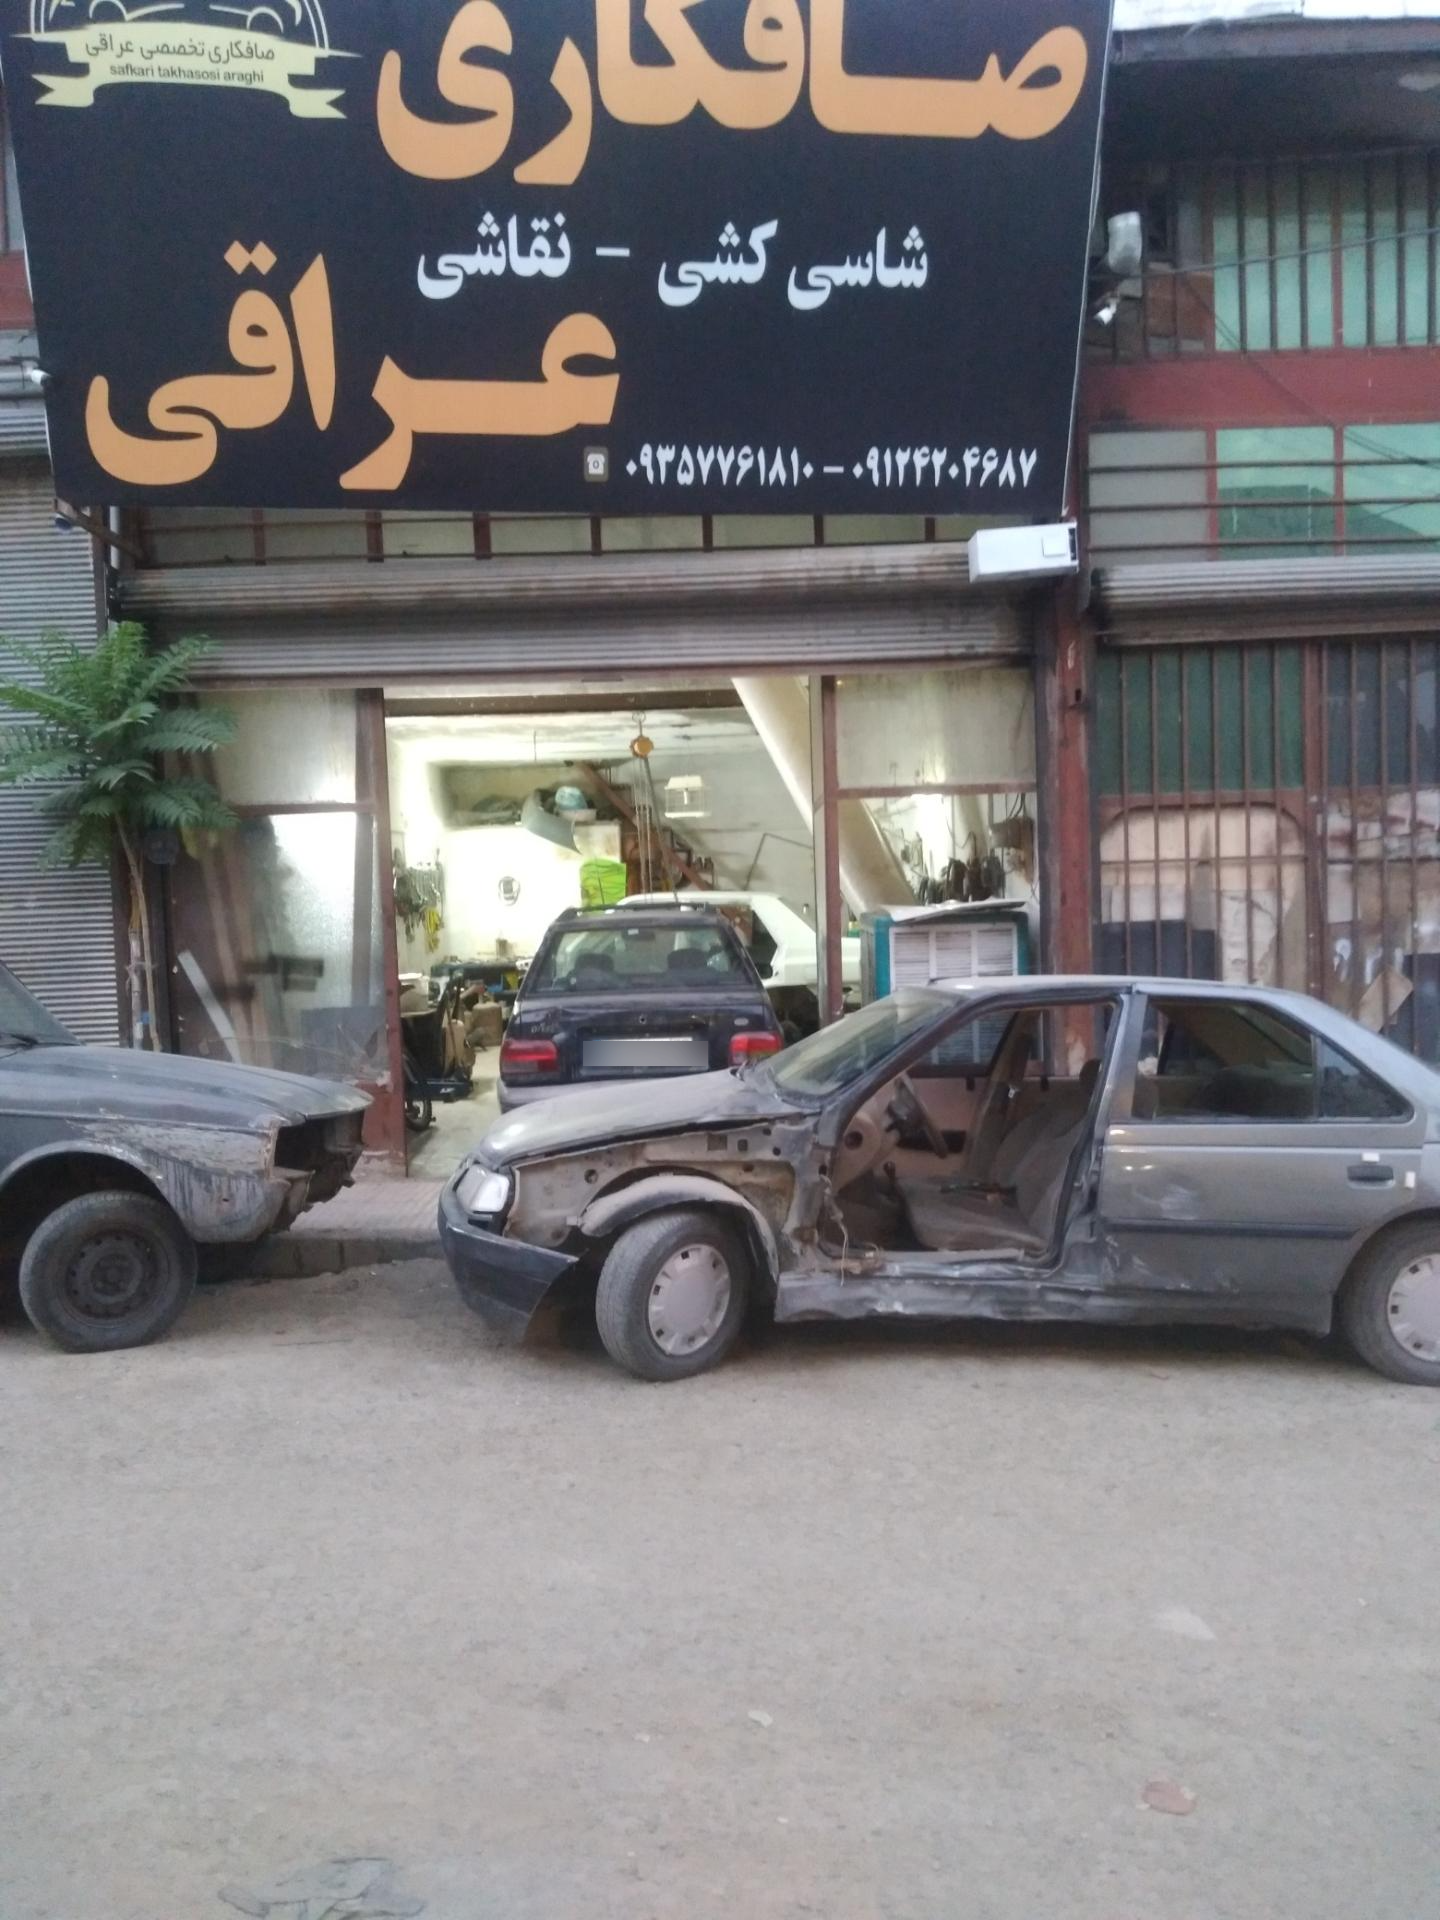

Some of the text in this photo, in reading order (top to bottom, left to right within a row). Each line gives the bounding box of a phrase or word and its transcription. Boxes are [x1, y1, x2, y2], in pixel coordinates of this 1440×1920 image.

[85, 33, 275, 64] صافکاری تخصصی عراقی
[109, 63, 264, 85] safkari takhasosi araghi
[377, 0, 1087, 184] صافکاری
[417, 211, 571, 299] نقاشی
[658, 219, 778, 306] کشی
[788, 226, 928, 311] شاسی
[86, 241, 620, 490] عراقی
